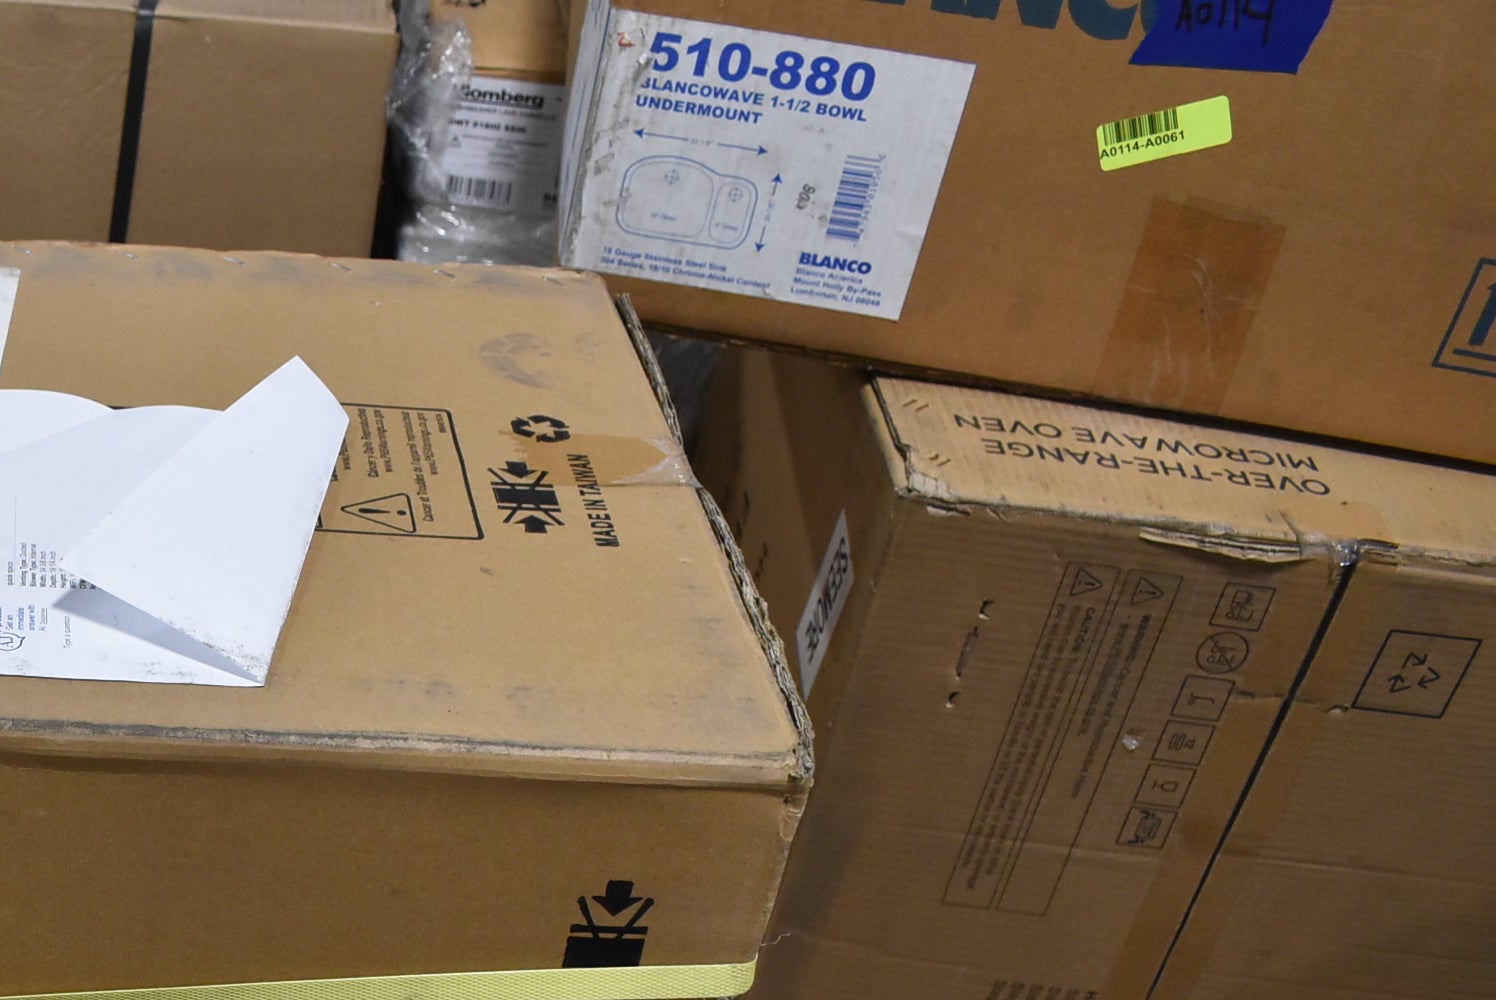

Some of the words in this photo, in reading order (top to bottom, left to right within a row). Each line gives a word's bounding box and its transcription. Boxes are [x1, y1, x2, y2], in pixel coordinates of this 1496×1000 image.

[650, 31, 876, 102] 510-880
[635, 94, 763, 124] UNDERMOUNT
[770, 94, 810, 113] 1-1/2
[815, 103, 867, 122] BOWL
[1099, 130, 1186, 160] A0114-A0061
[798, 251, 873, 275] BLANCO
[954, 413, 1062, 439] OVEN
[1072, 426, 1319, 472] MICROWAVE
[566, 454, 602, 498] TAIWAN
[981, 438, 1330, 496] OVER-THE-RANGE
[420, 502, 434, 522] Cancer
[584, 499, 608, 512] IN
[587, 513, 620, 547] MADE
